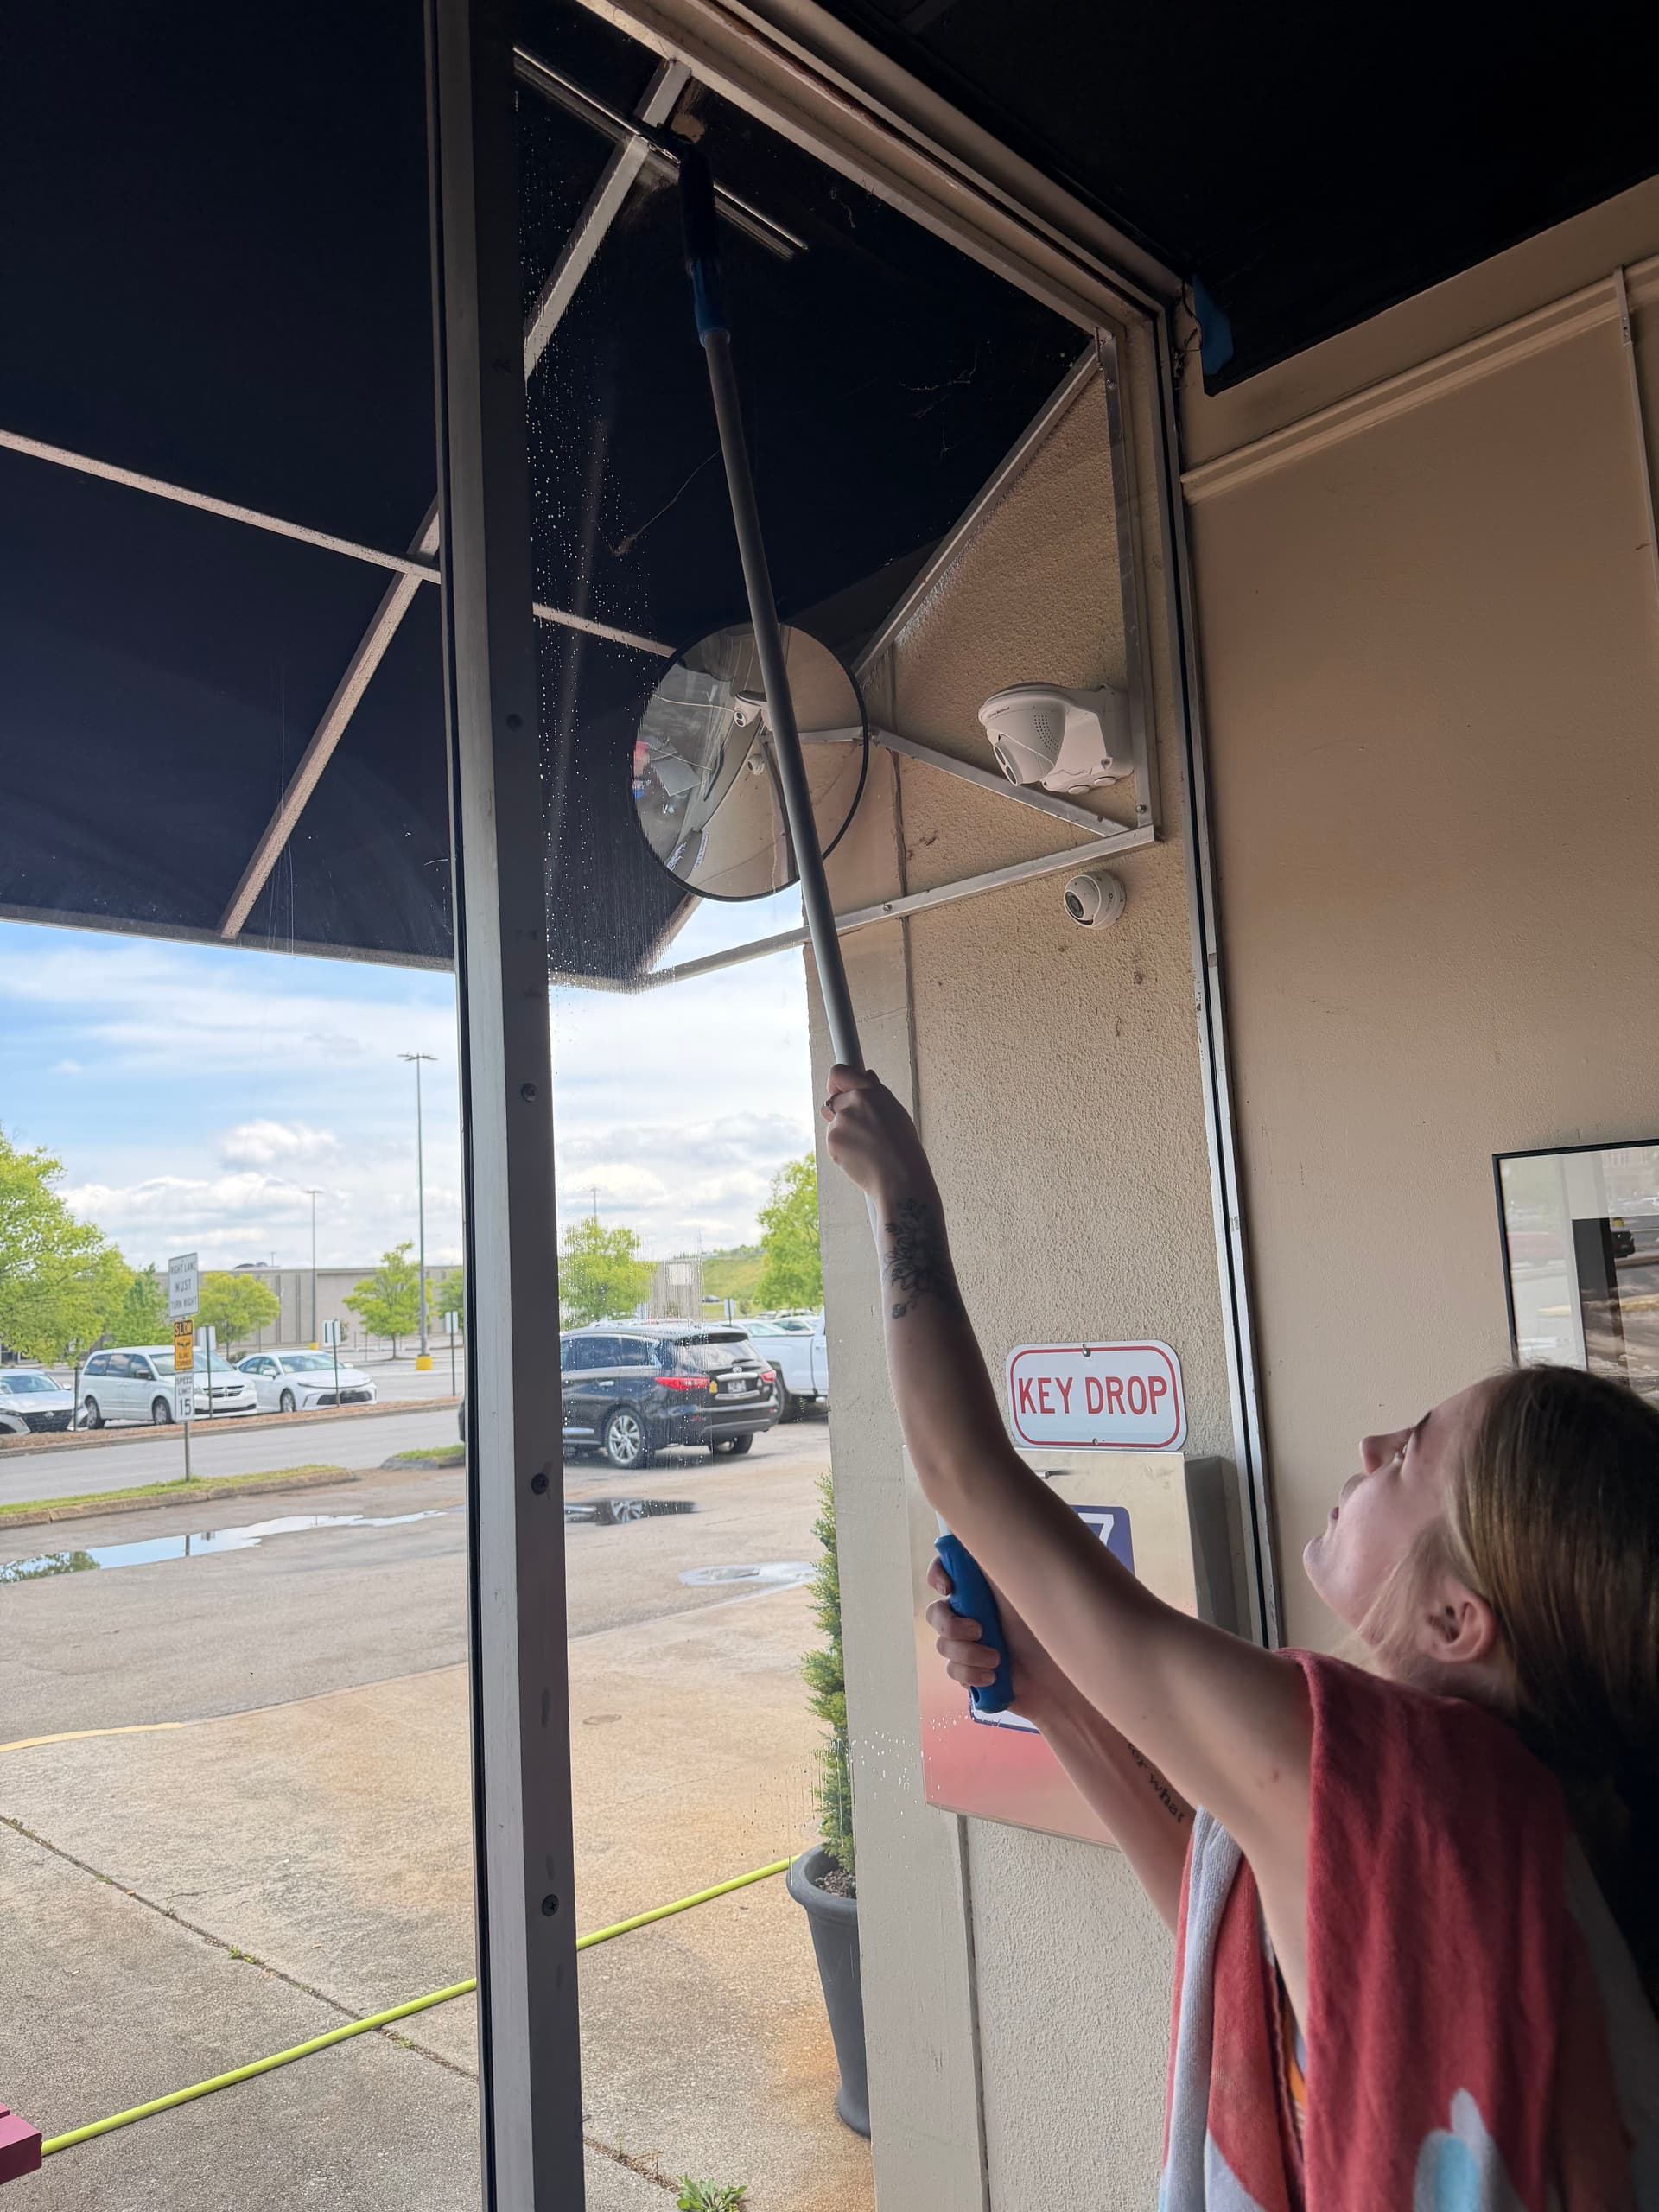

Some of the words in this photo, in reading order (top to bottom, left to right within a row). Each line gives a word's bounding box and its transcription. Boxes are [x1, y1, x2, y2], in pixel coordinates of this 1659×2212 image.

[175, 1278, 191, 1294] MUST
[175, 1321, 192, 1336] SLOW
[1018, 1377, 1073, 1414] KEY
[1085, 1376, 1167, 1415] DROP
[179, 1398, 192, 1416] 15
